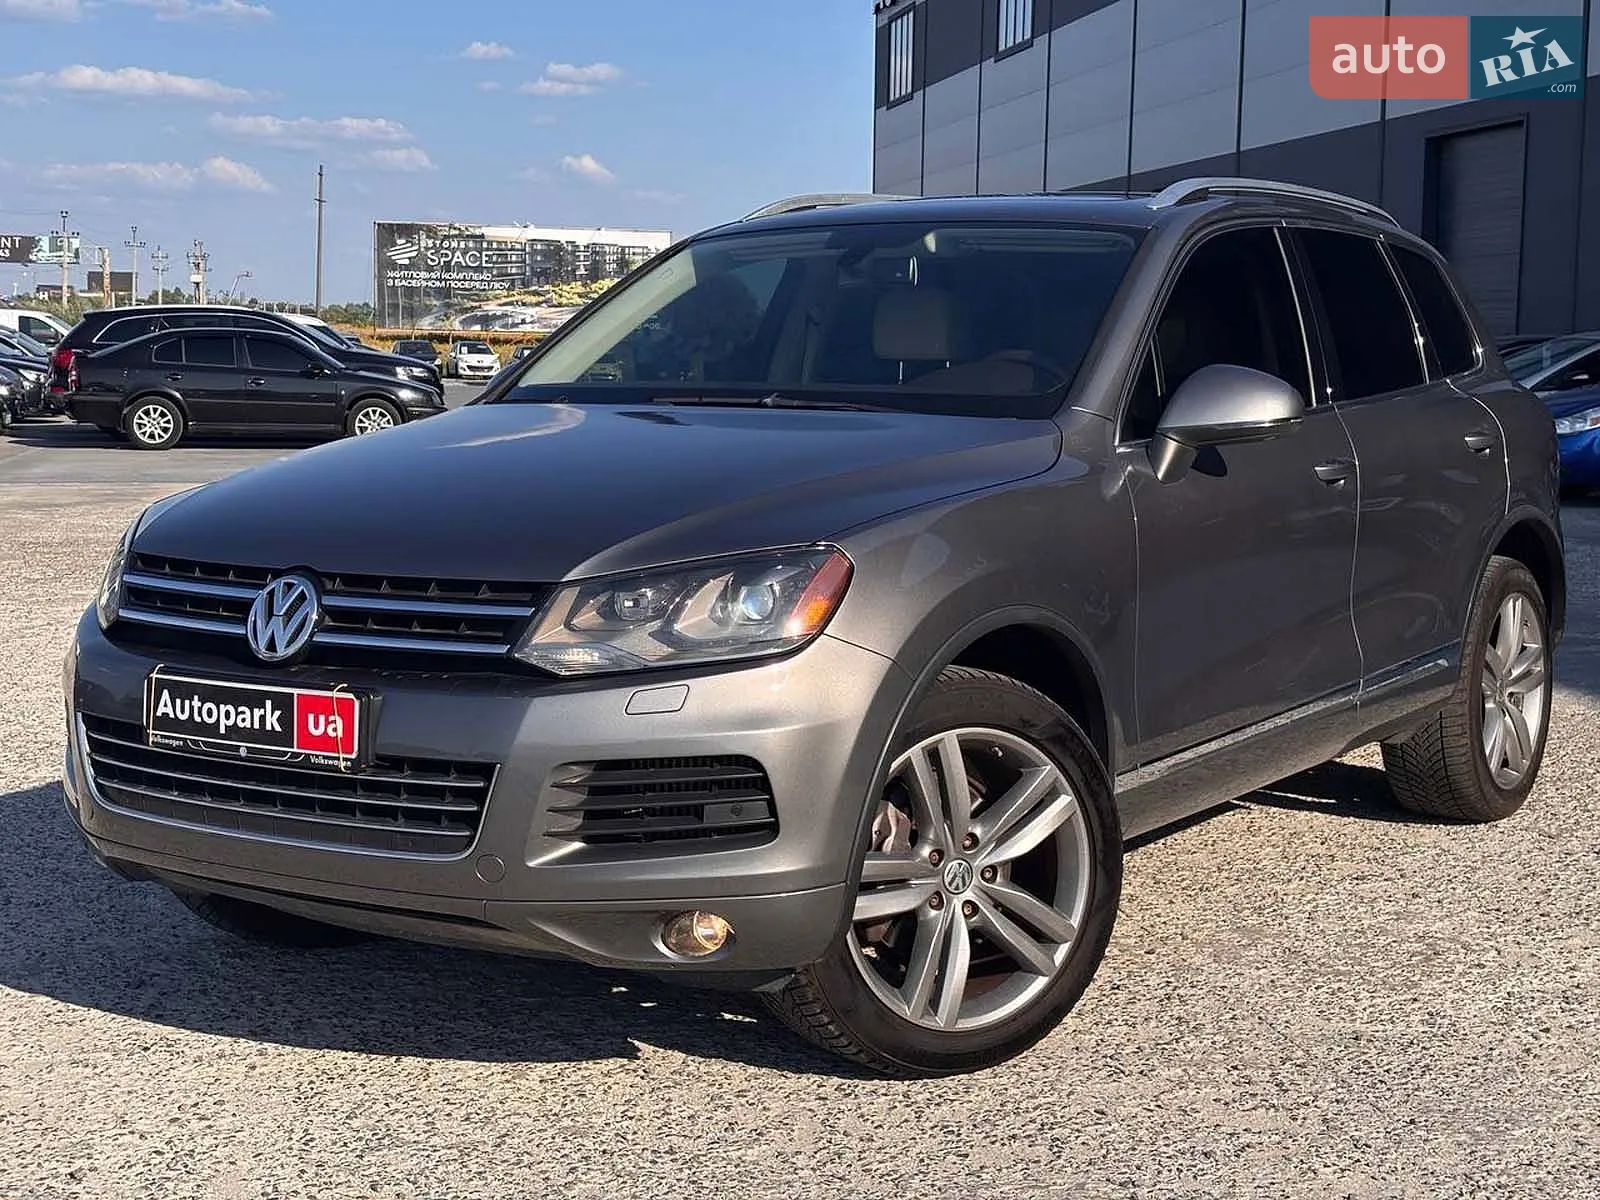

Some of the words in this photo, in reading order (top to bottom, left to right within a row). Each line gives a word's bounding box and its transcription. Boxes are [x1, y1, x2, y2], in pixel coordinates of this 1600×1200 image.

[426, 249, 494, 267] SPACE
[386, 270, 441, 279] ЖИТЛОВИЙ
[395, 279, 446, 288] БАСЕЙНОМ
[447, 280, 489, 290] ПОСЕРЕД
[156, 688, 282, 734] Autopark
[307, 712, 344, 738] ua
